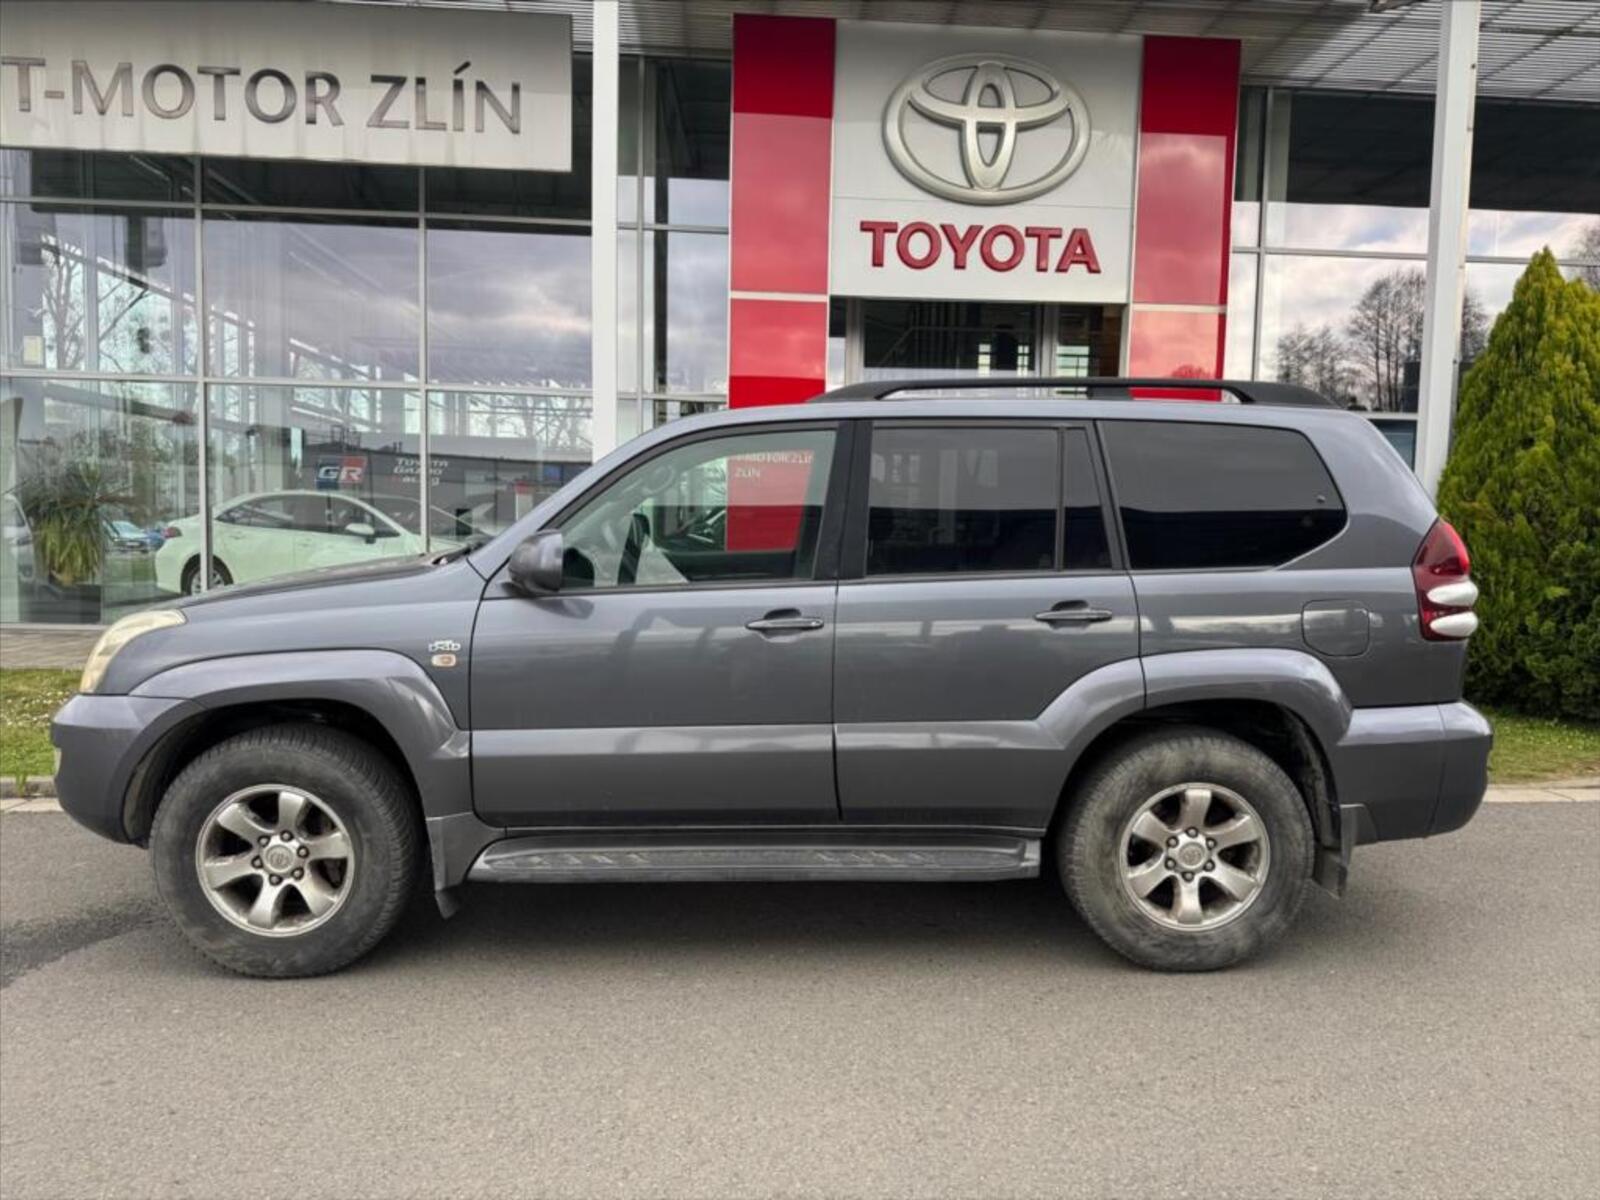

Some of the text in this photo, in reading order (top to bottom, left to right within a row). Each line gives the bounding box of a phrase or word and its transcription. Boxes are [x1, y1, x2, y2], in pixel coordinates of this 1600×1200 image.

[1, 55, 521, 134] T-MOTOR ZLÍN
[860, 220, 1102, 273] TOYOTA
[318, 465, 363, 480] GR
